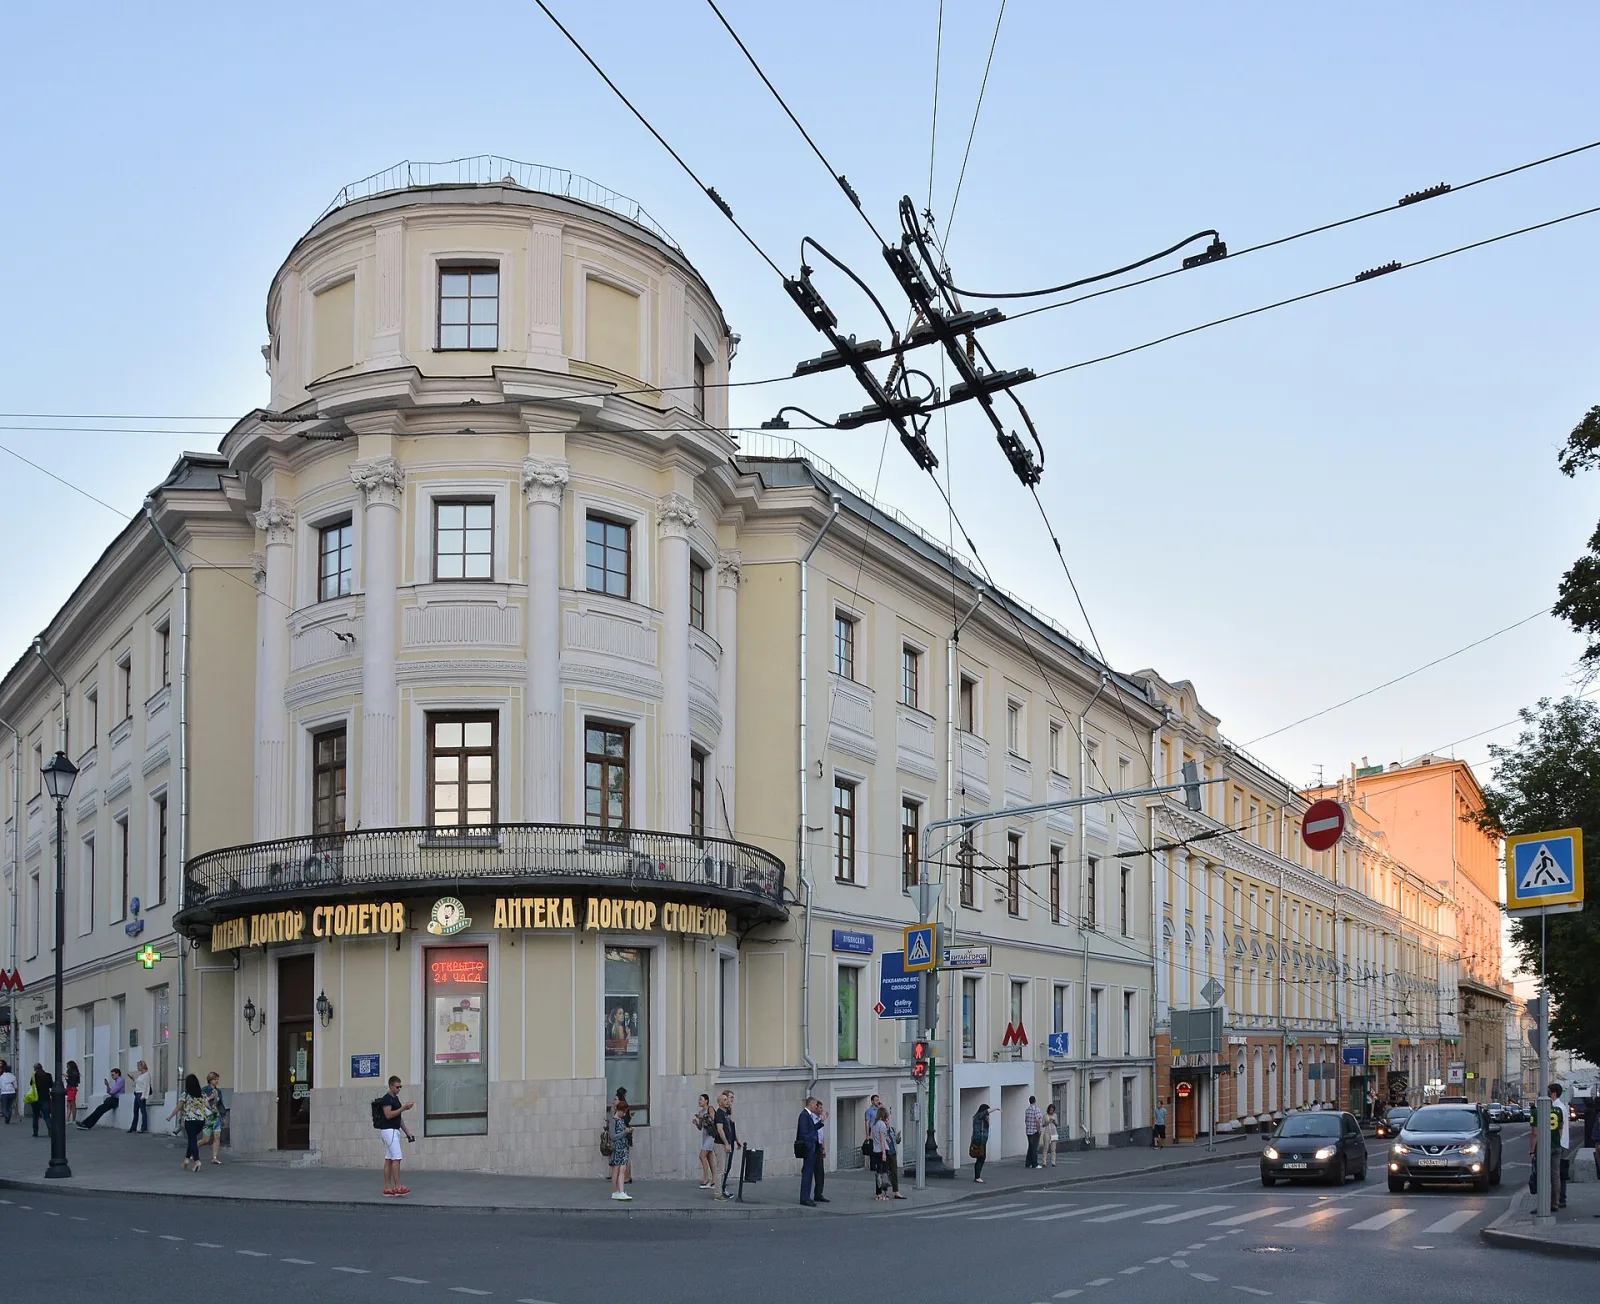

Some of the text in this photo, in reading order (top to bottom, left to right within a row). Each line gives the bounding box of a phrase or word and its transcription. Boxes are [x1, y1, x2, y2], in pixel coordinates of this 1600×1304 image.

[494, 897, 727, 936] АПТЕКА ДОКТОР СТОЛЕТОВ
[211, 902, 405, 952] АПТЕКА ДОКТОР СТОЛЕТОВ
[951, 953, 987, 961] КИТАЙ-ГОРОД
[431, 962, 485, 972] ОТКРЫТО
[434, 973, 481, 983] 24 ЧАСА
[894, 999, 913, 1008] Gallery
